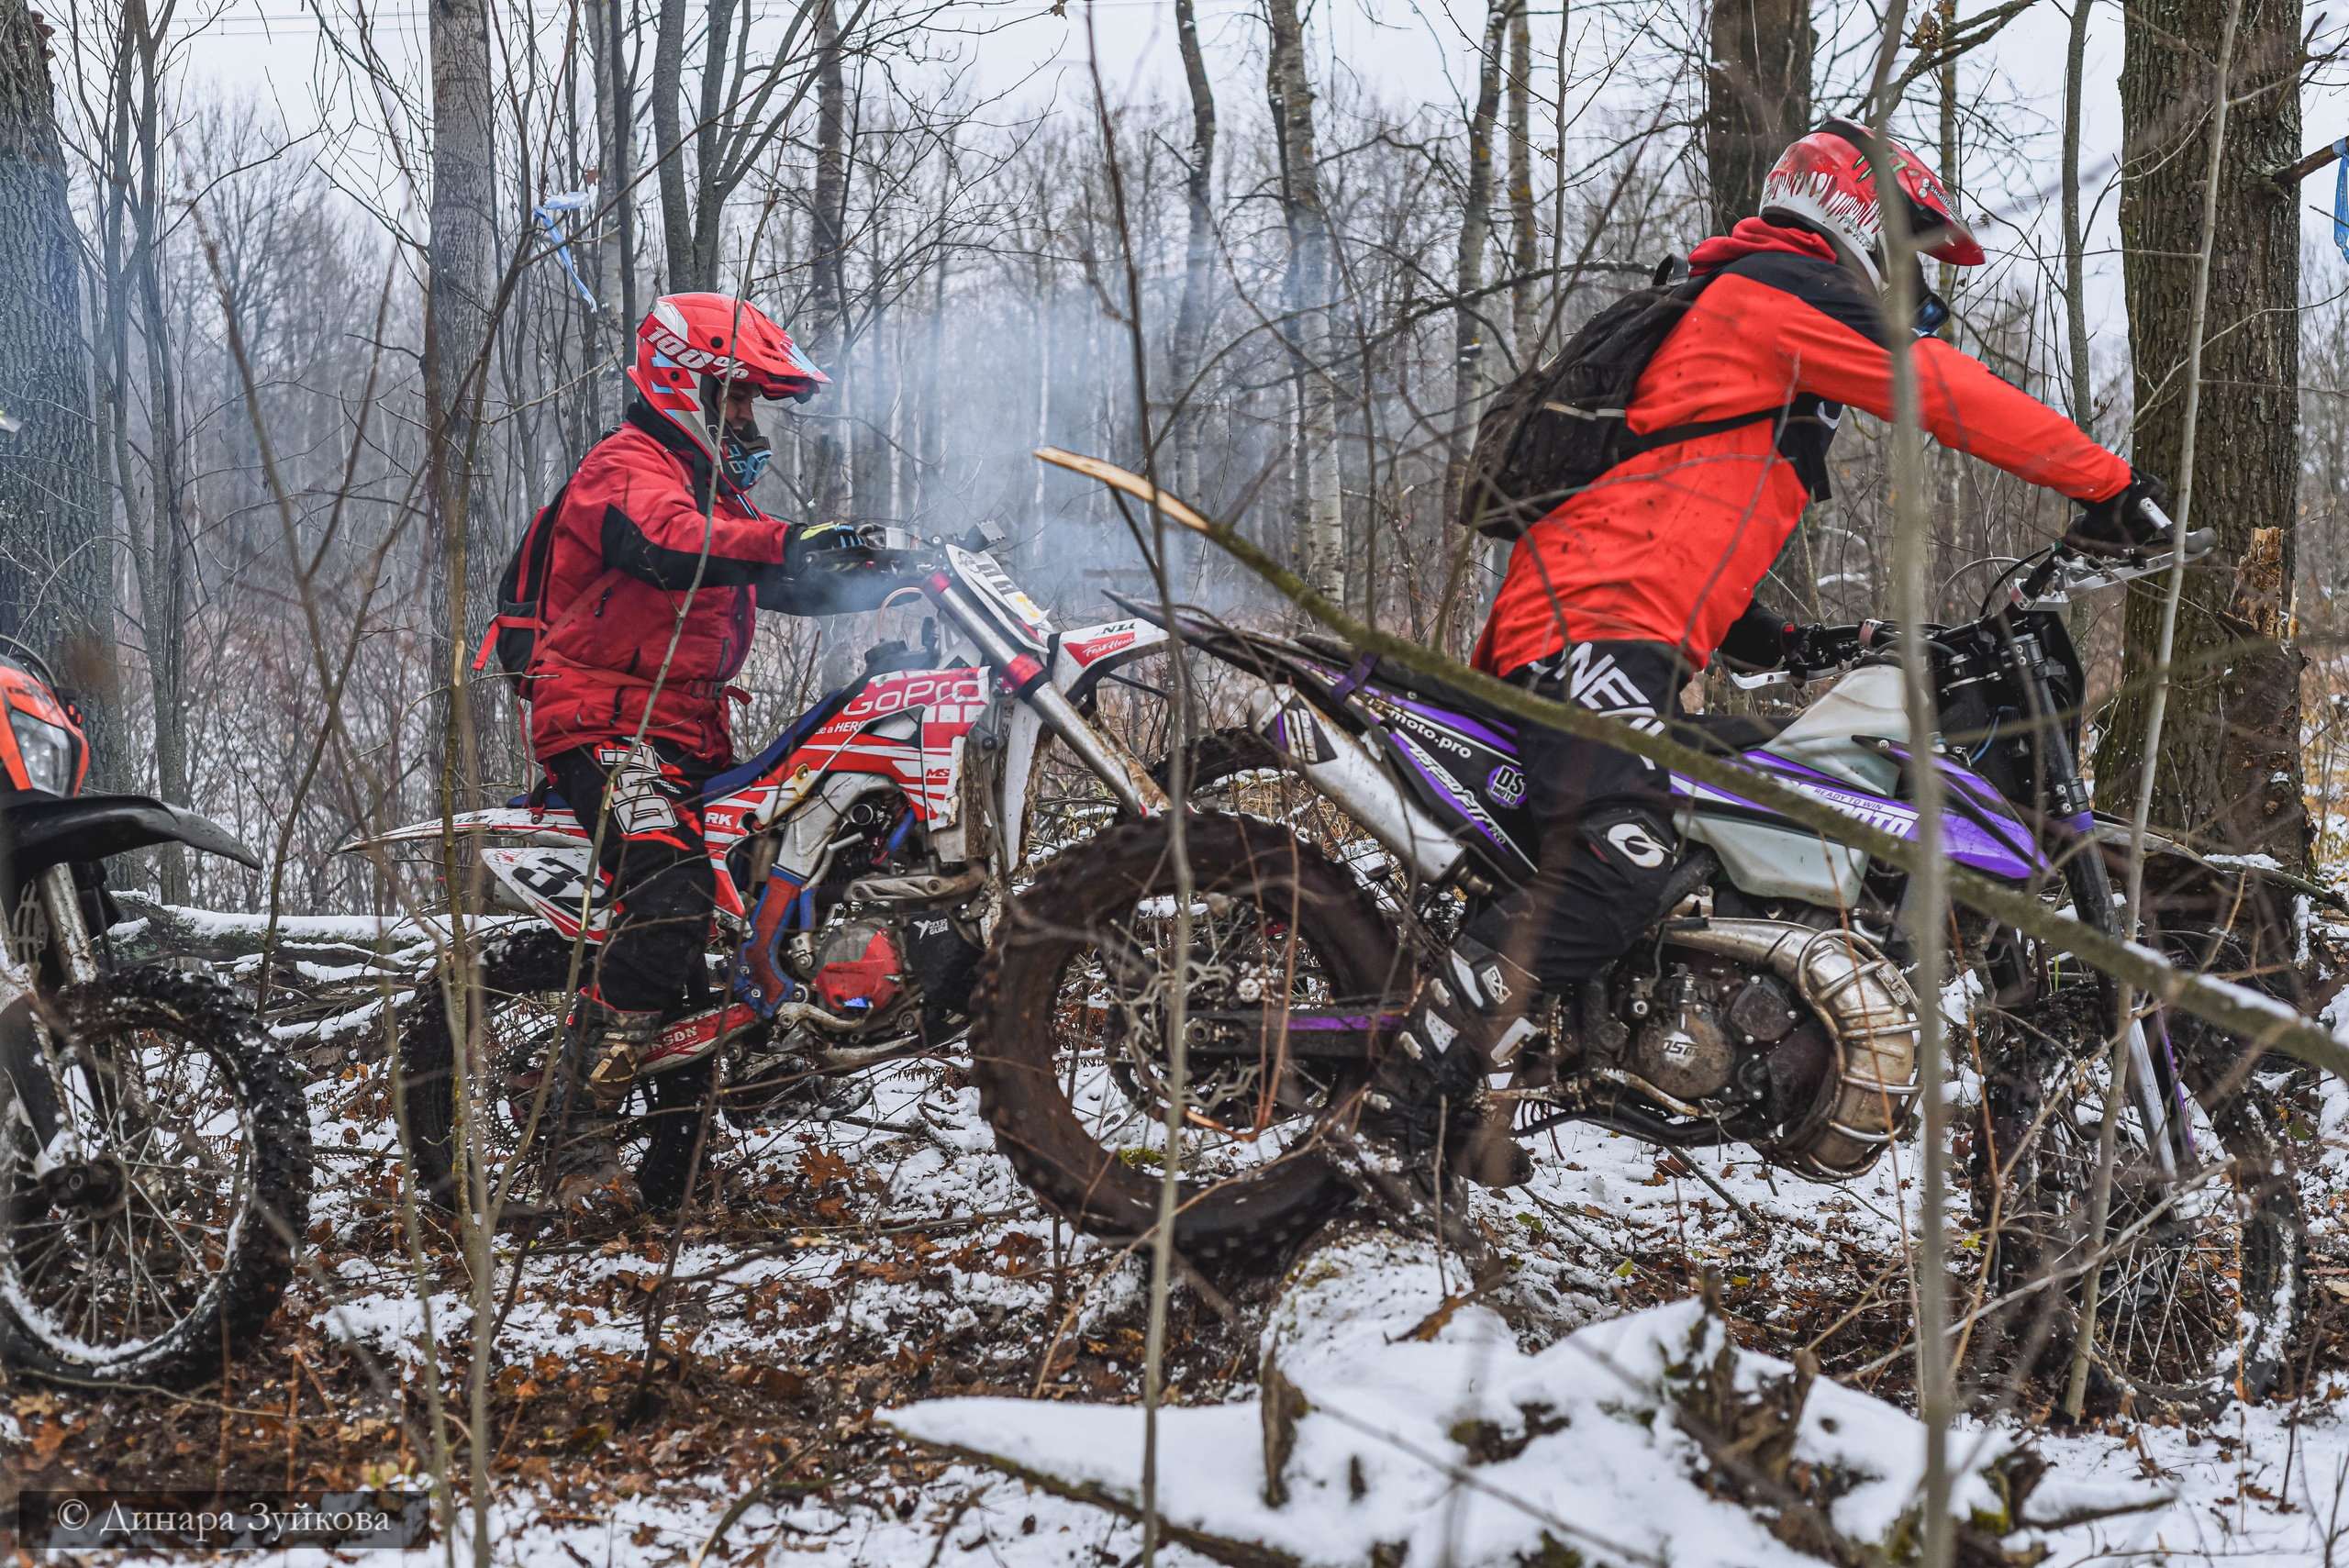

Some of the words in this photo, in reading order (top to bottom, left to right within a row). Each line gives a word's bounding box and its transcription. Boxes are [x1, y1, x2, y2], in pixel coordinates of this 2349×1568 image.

[647, 325, 750, 379] 100%
[842, 680, 979, 716] GoPro
[1495, 765, 1525, 795] DS
[1492, 784, 1520, 805] MOTO
[1813, 787, 1844, 803] READY
[1849, 796, 1862, 806] TO
[1864, 800, 1884, 811] WIN
[705, 812, 733, 826] RK
